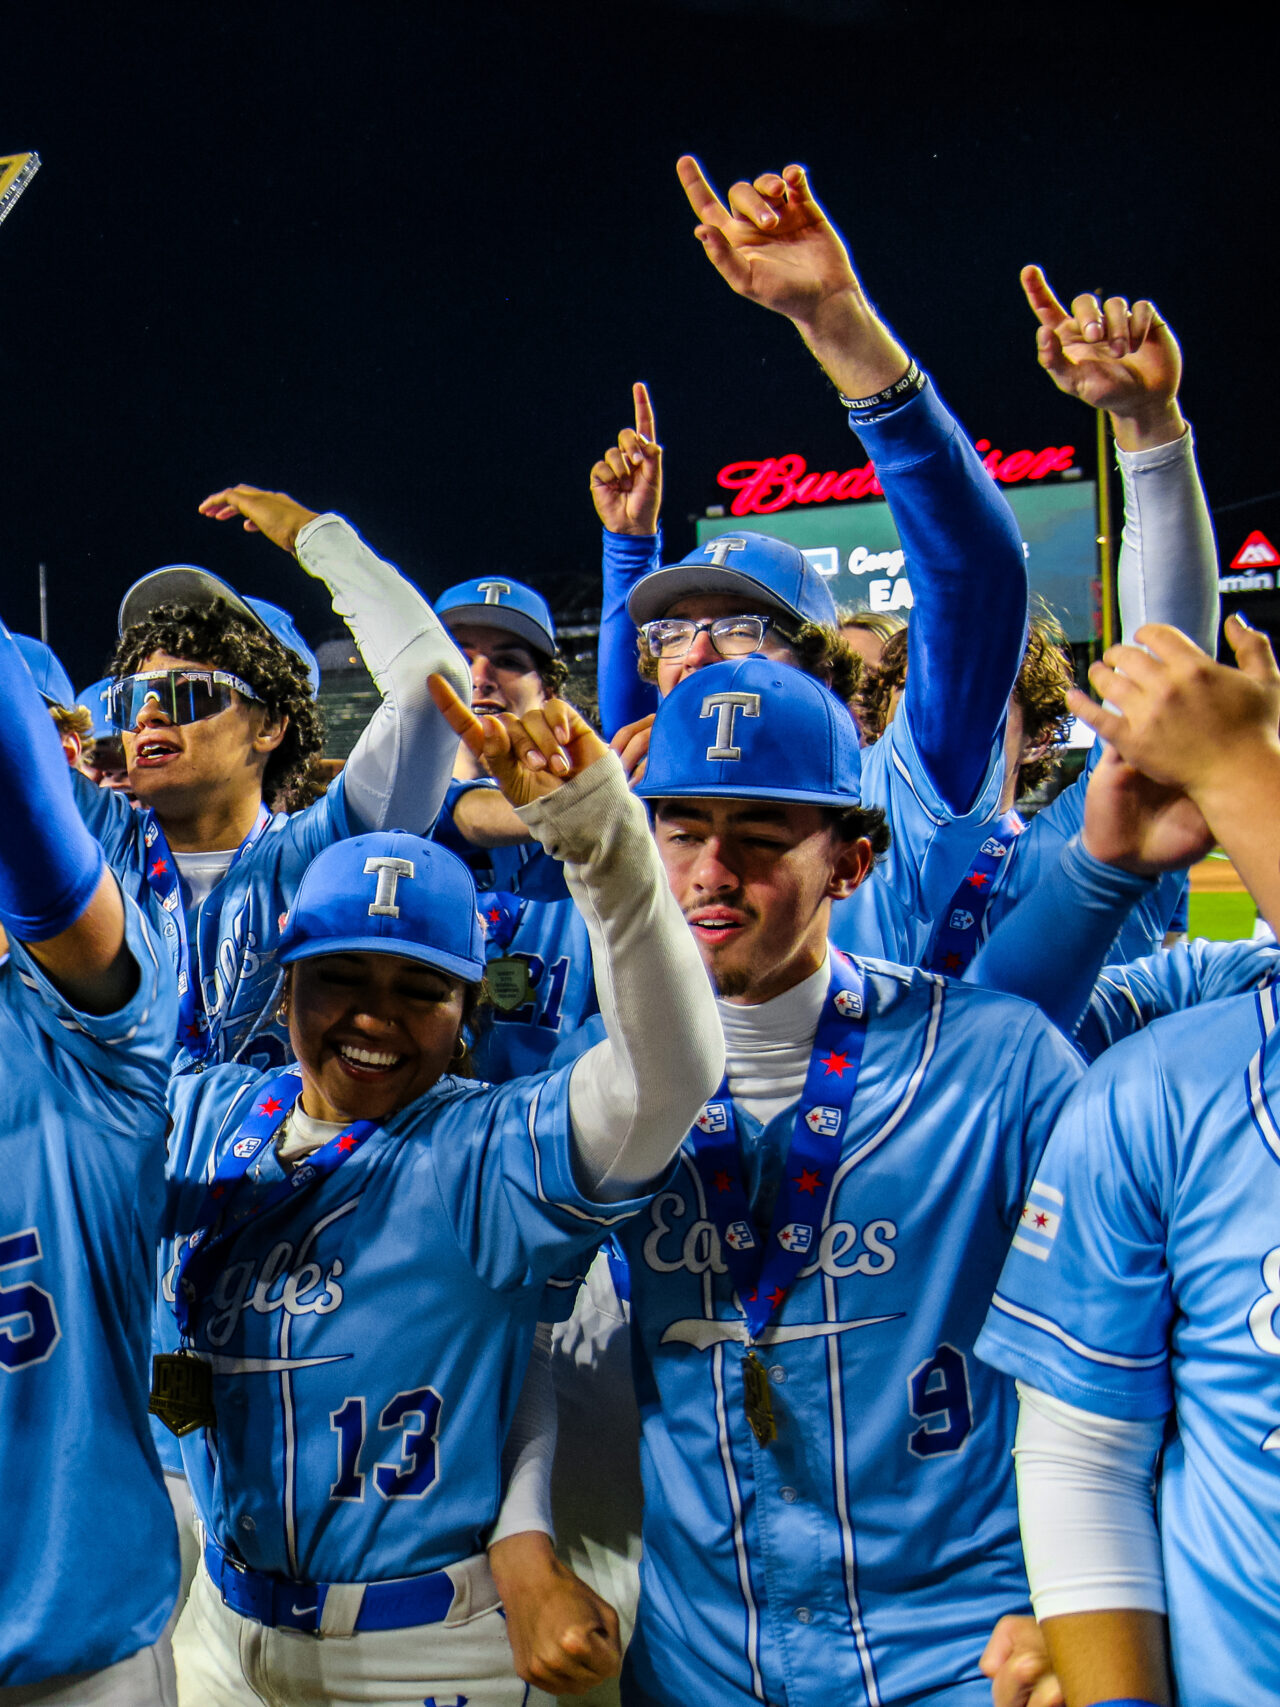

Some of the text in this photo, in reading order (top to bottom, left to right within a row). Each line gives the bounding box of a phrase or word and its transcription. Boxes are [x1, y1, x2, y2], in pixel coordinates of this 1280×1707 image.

[703, 537, 748, 565] T
[477, 581, 511, 605] T
[698, 692, 761, 761] T
[363, 856, 415, 919] T
[846, 990, 863, 1018] CPL
[706, 1105, 727, 1132] CPL
[818, 1107, 840, 1136] CPL
[239, 1138, 262, 1158] CPL
[643, 1192, 899, 1278] Eaes
[733, 1222, 754, 1250] CPL
[789, 1224, 813, 1253] CPL
[906, 1342, 974, 1461] 9
[328, 1385, 444, 1502] 13
